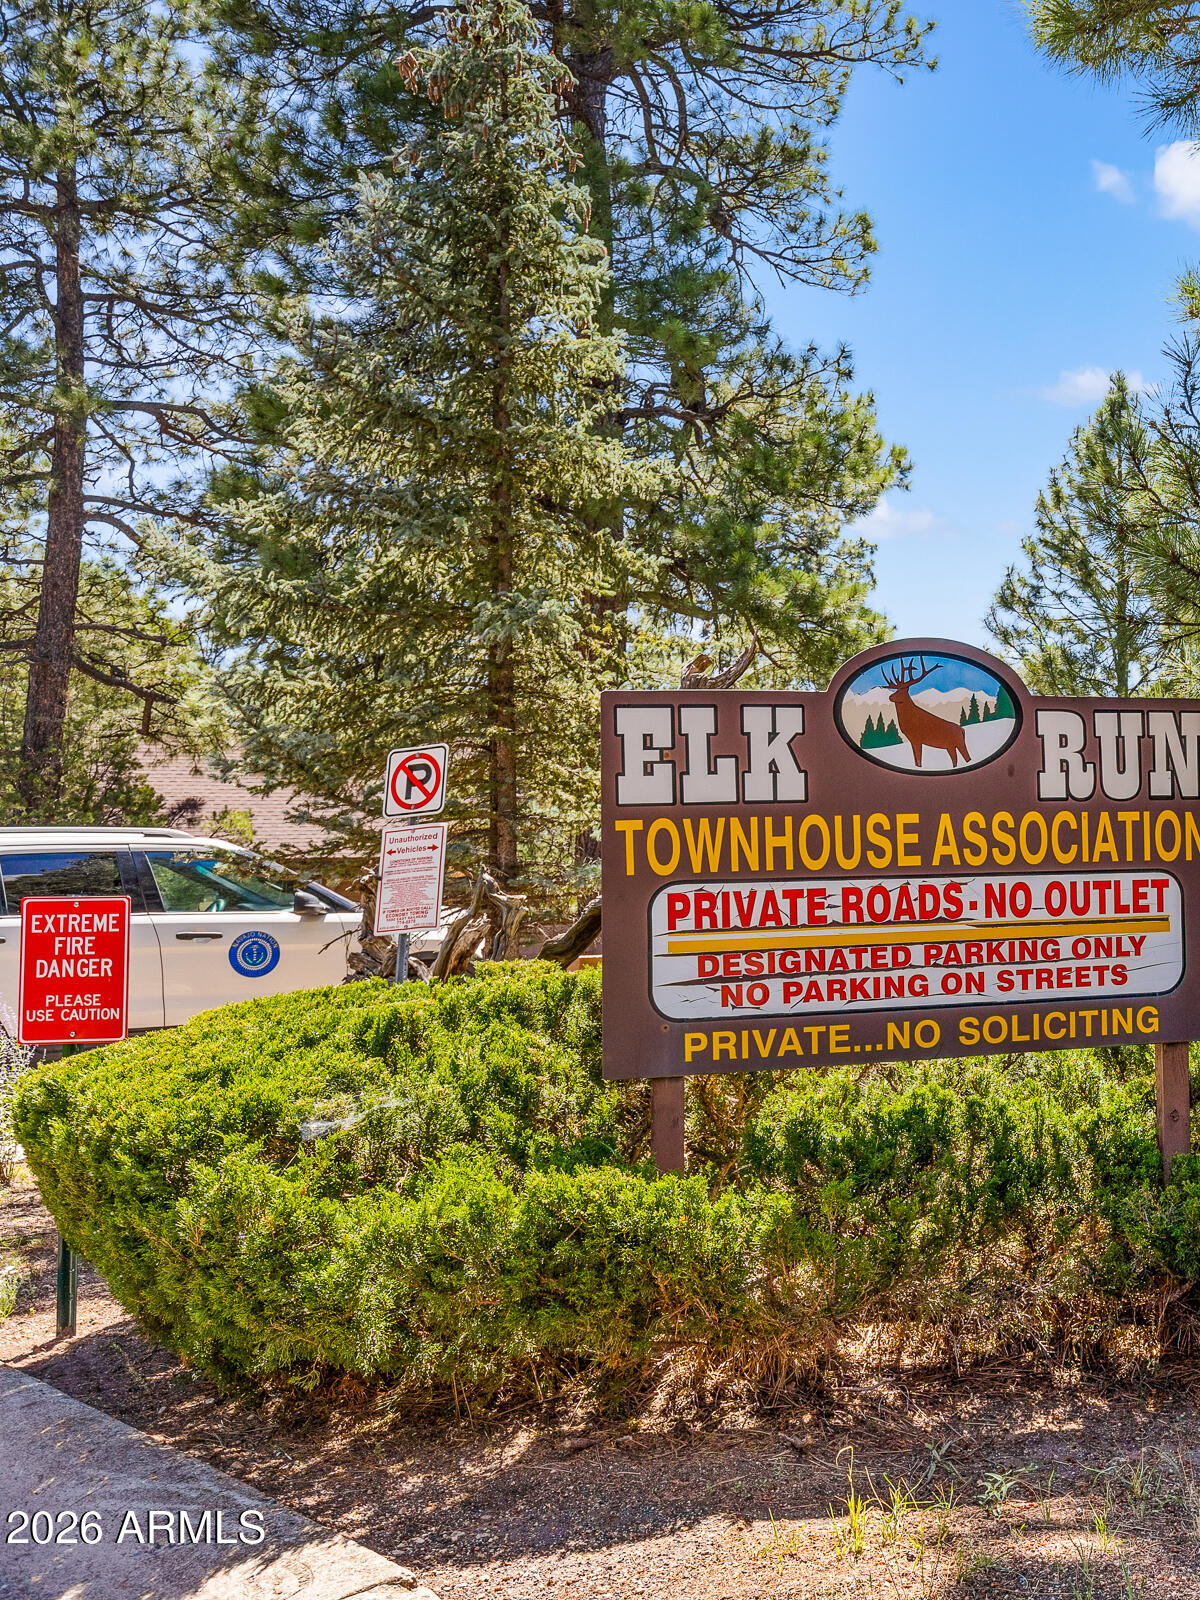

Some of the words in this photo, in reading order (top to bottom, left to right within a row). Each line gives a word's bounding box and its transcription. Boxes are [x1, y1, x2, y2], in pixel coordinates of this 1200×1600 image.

[614, 704, 808, 806] ELK
[389, 833, 438, 844] Unauthorized
[615, 812, 921, 876] TOWNHOUSE
[397, 845, 427, 854] Vehicles
[667, 888, 827, 930] PRIVATE
[1044, 879, 1169, 917] OUTLET
[31, 914, 120, 933] EXTREME
[54, 936, 96, 955] FIRE
[232, 932, 255, 948] NAVAJO
[258, 932, 279, 948] NATION
[698, 945, 912, 977] DESIGNATED
[924, 939, 1061, 966] PARKING
[1072, 935, 1147, 959] ONLY
[36, 958, 113, 978] DANGER
[721, 982, 770, 1008] NO
[783, 974, 928, 1004] PARKING
[941, 971, 985, 995] ON
[997, 964, 1128, 992] STREETS
[45, 994, 101, 1007] PLEASE
[26, 1009, 54, 1022] USE
[60, 1007, 120, 1021] CAUTION
[958, 1006, 1159, 1045] SOLICITING
